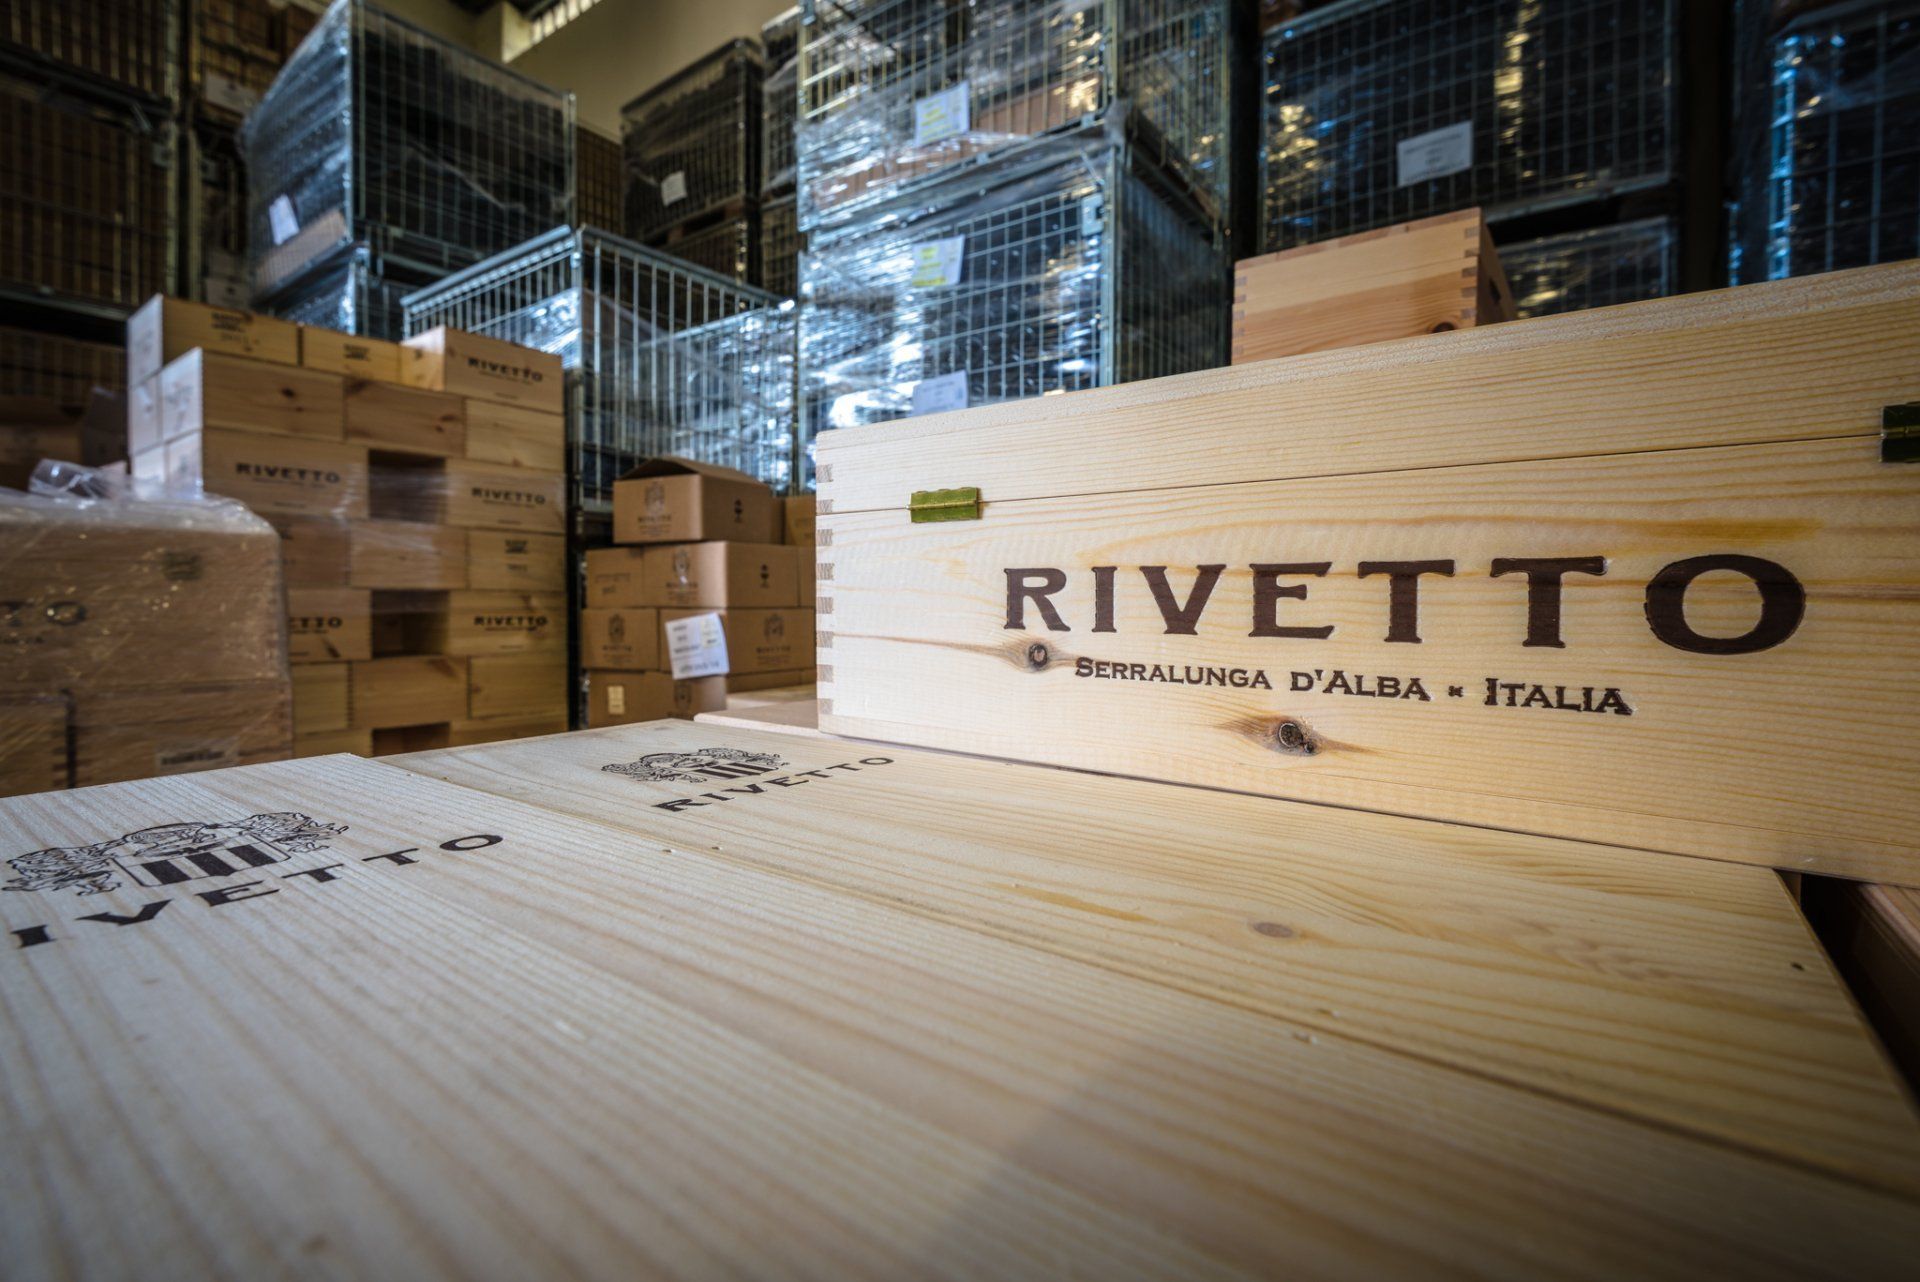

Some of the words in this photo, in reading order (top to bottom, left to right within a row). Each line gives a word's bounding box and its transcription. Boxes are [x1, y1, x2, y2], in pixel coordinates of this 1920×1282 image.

[467, 357, 543, 382] RIVETTO
[236, 462, 340, 483] RIVETTO
[472, 487, 546, 505] RIVETTO
[1003, 553, 1806, 655] RIVETTO
[474, 615, 548, 627] RIVETTO
[1074, 656, 1273, 690] SERRALUNGA
[1483, 677, 1634, 716] ITALIA
[652, 756, 894, 812] RIVETTO
